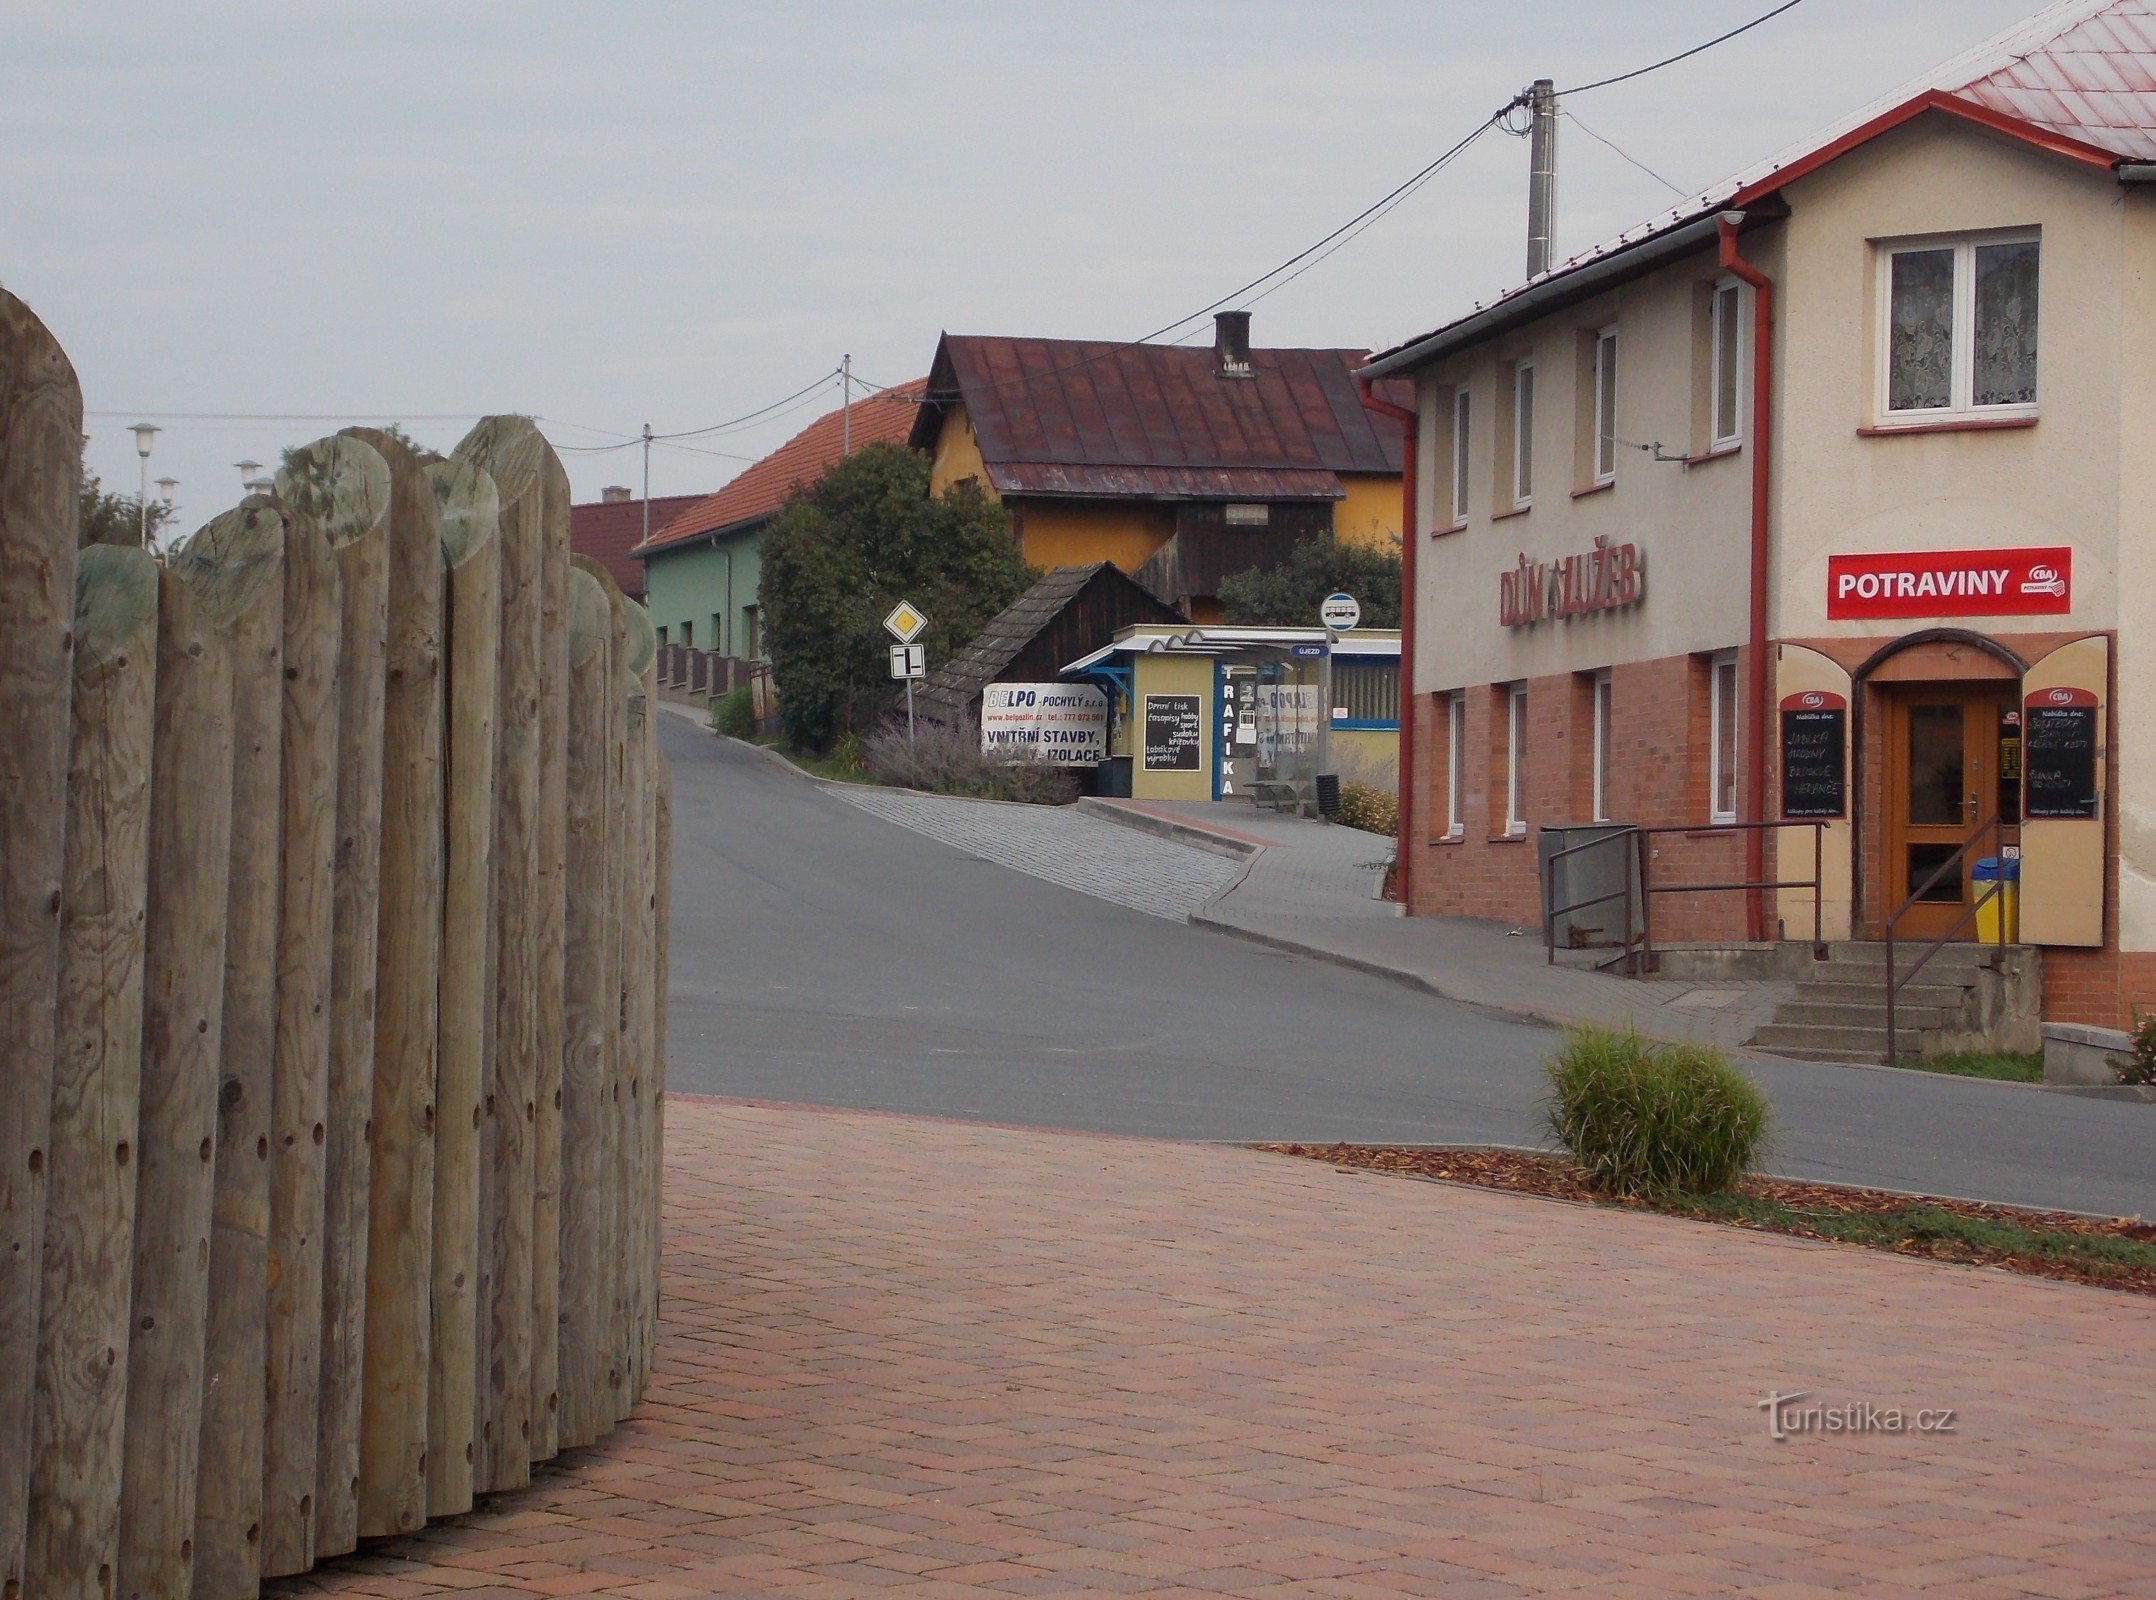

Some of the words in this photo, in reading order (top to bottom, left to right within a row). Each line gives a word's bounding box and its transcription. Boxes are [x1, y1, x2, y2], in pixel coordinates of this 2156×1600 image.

[1838, 569, 2010, 599] POTRAVINY
[1298, 646, 1320, 655] ÚJEZD
[988, 690, 1037, 708] BELPO
[1174, 702, 1189, 710] tisk
[1064, 713, 1076, 721] 777
[987, 727, 1040, 743] VNITŘNÍ
[1043, 730, 1100, 745] STAVBY,
[1223, 666, 1235, 794] TRAFIKA
[1047, 748, 1100, 762] IZOLACE
